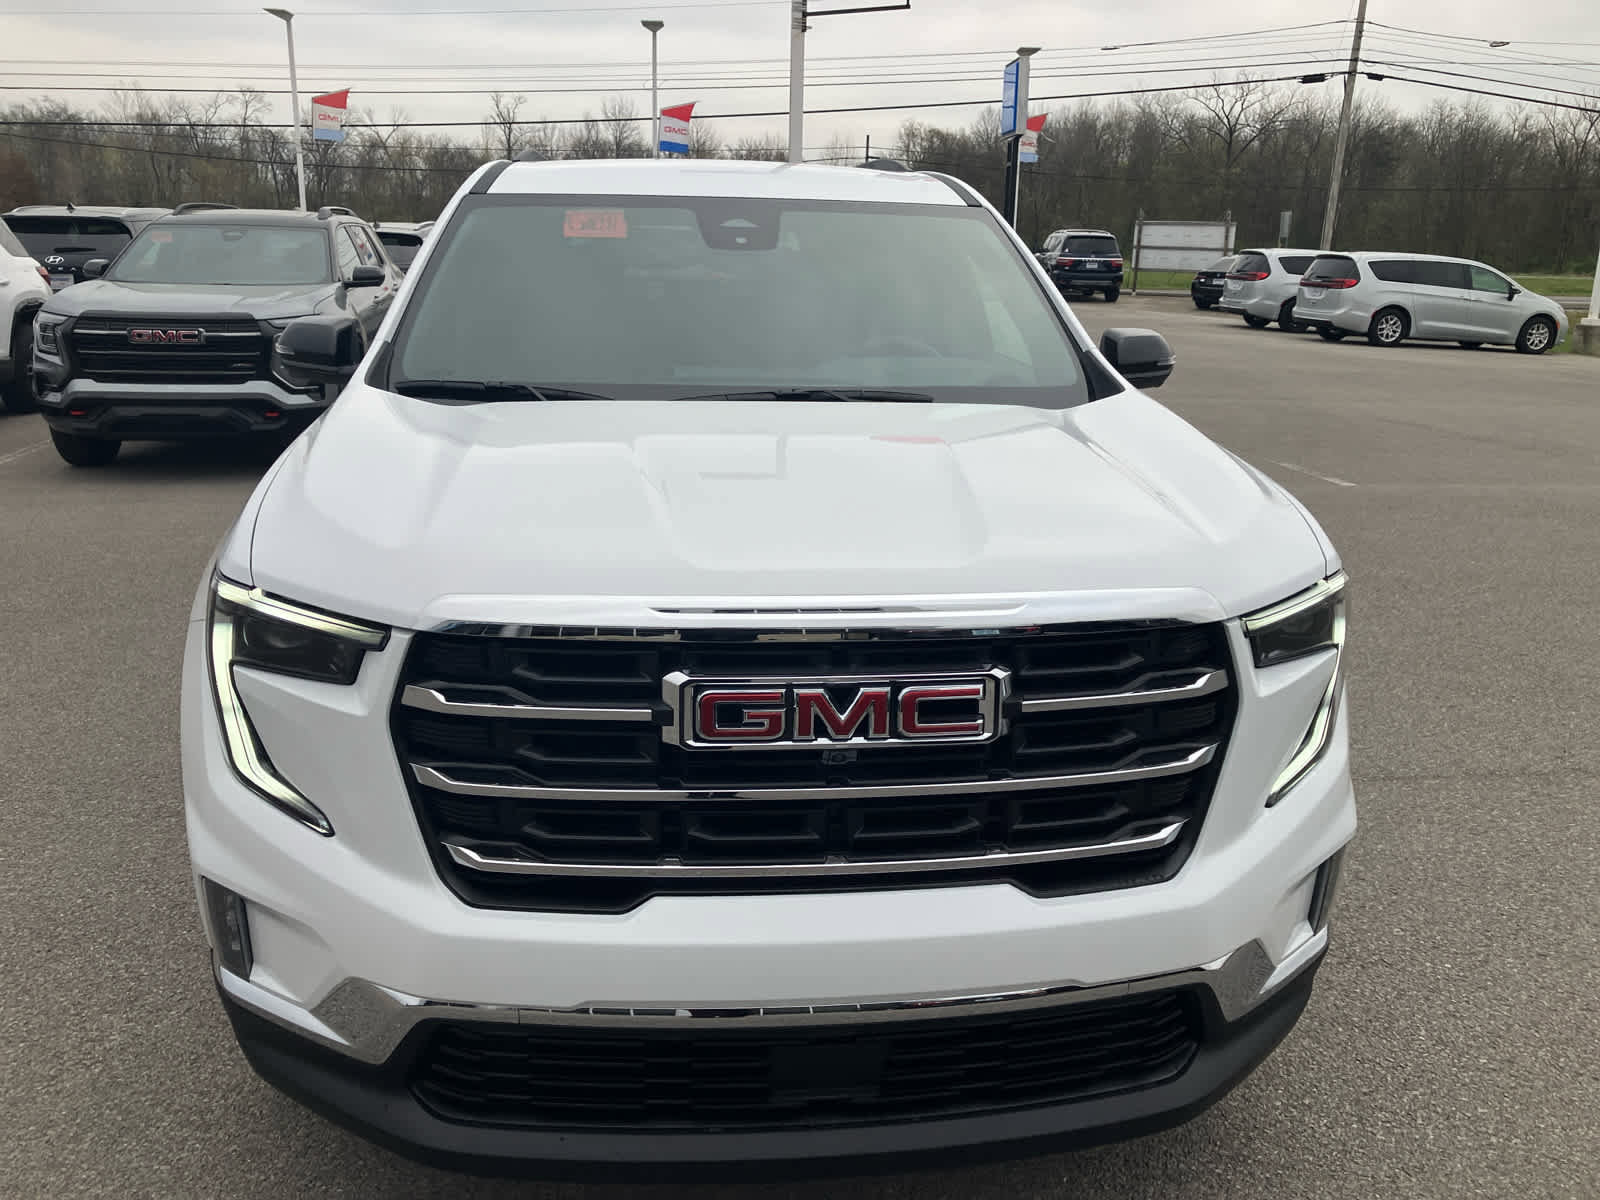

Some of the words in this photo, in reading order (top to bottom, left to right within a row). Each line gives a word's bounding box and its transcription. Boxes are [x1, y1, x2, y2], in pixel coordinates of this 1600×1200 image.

[664, 126, 688, 135] GMC
[131, 328, 199, 342] GMC
[697, 684, 985, 740] GMC
